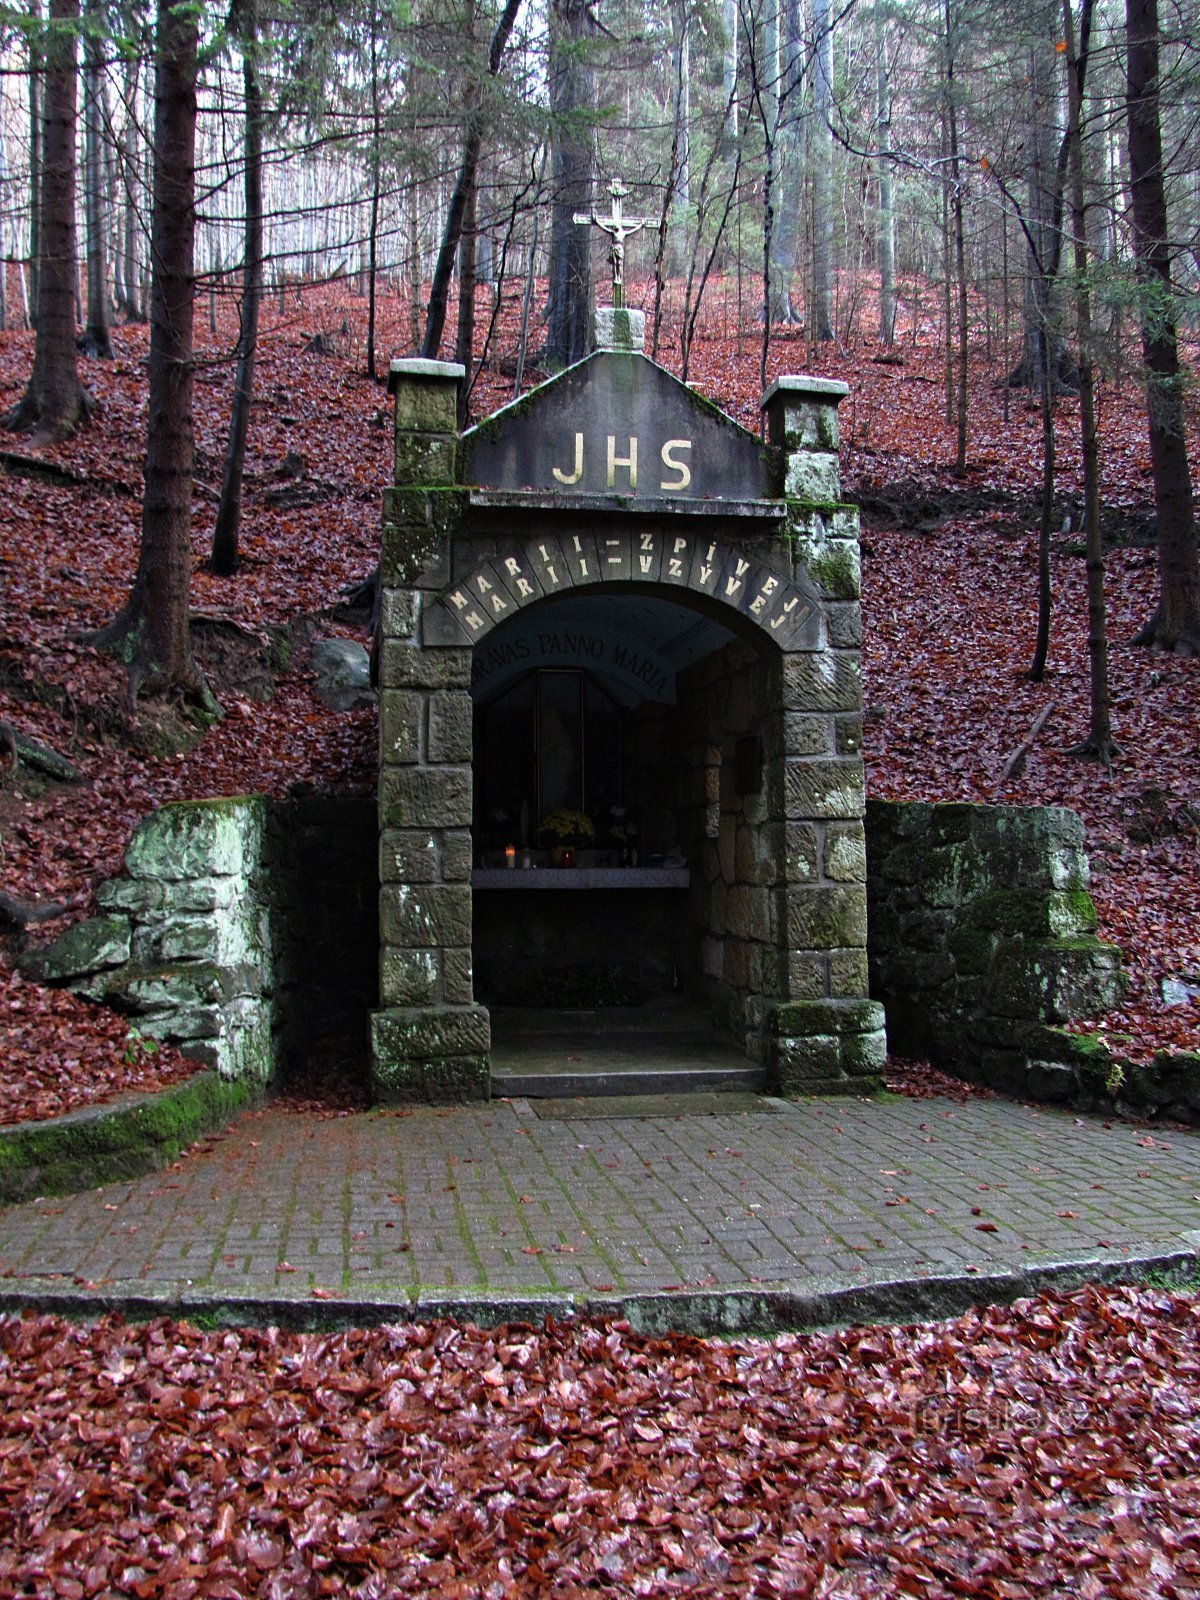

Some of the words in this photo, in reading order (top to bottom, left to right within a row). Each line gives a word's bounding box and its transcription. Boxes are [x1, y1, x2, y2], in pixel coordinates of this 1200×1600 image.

[552, 432, 692, 491] JHS
[449, 535, 583, 610] MARII
[465, 558, 589, 631] MARII
[537, 632, 604, 658] PANNO
[610, 644, 669, 696] MARIA
